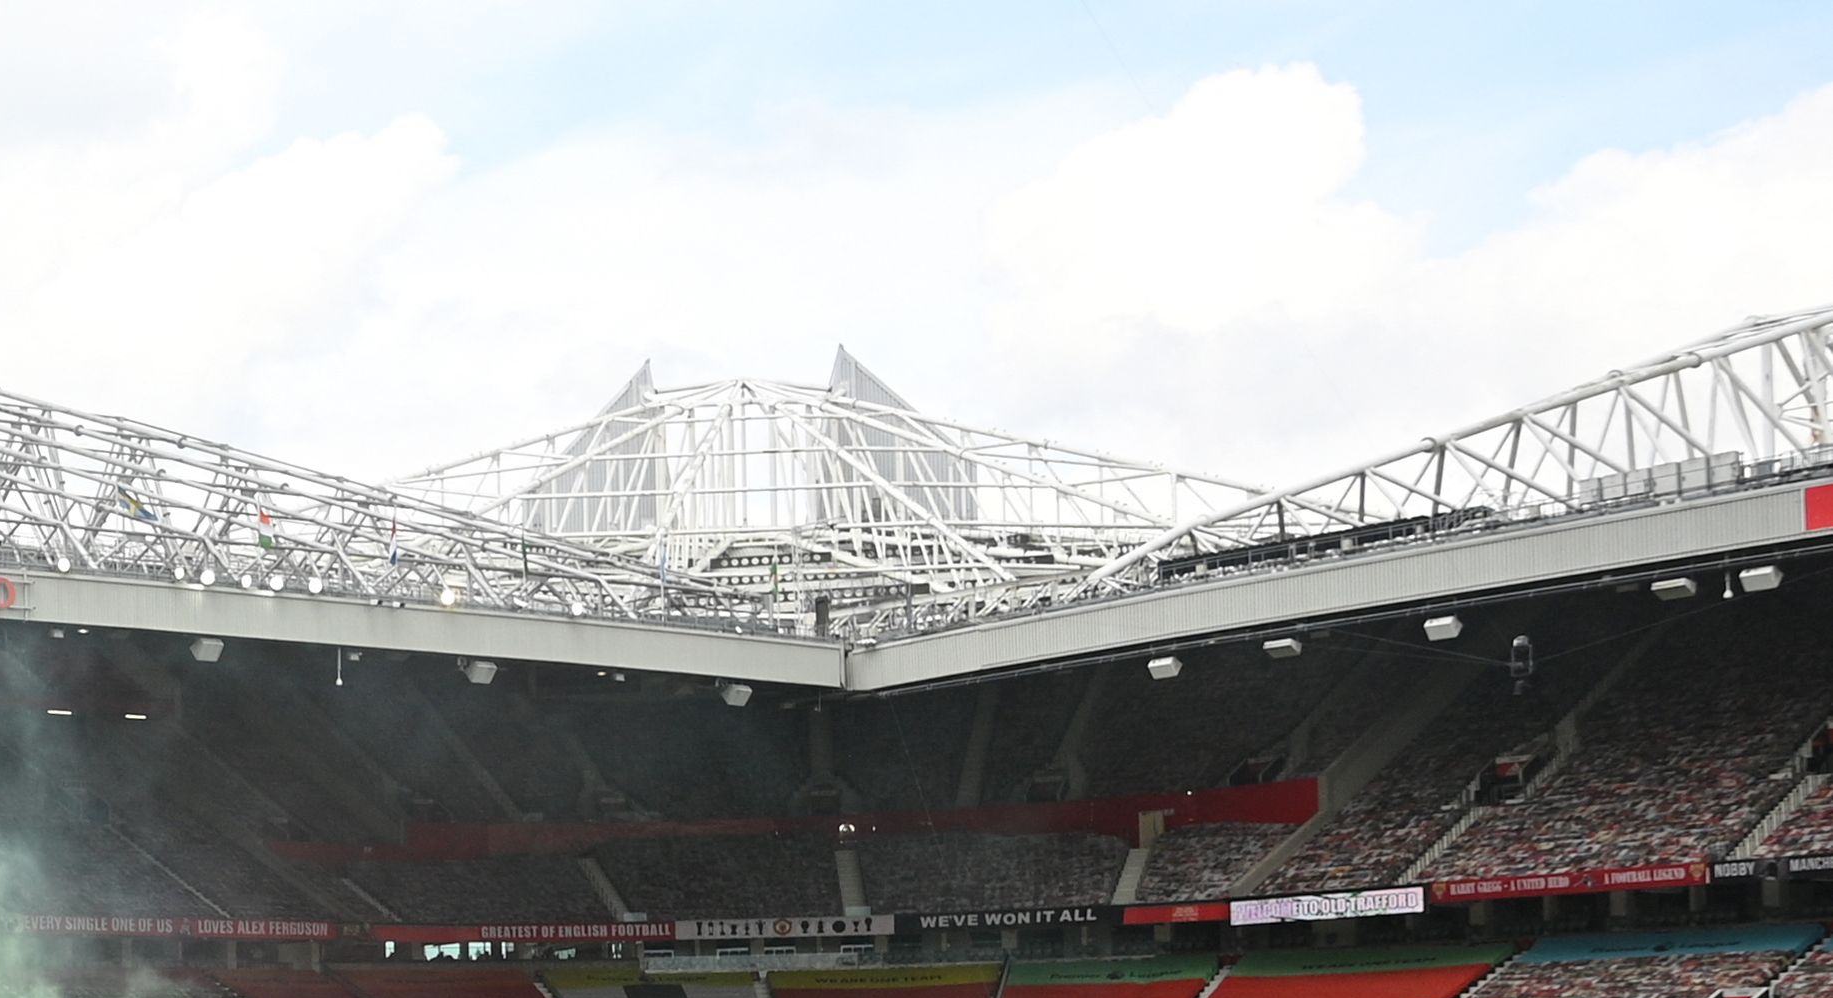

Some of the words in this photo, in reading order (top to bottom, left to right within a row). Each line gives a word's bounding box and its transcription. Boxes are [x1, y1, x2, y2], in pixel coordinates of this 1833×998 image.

[1714, 861, 1756, 878] NOBBY
[1302, 902, 1318, 915] TO
[1322, 899, 1349, 914] OLD
[1351, 893, 1416, 912] TRAFFORD
[26, 915, 62, 931] EVERY
[65, 916, 108, 932] SINGLE
[111, 917, 136, 932] ONE
[138, 918, 154, 932] OF
[157, 919, 173, 933] US
[920, 913, 979, 928] WE'VE
[985, 911, 1031, 926] WON
[1036, 910, 1055, 923] IT
[1059, 908, 1097, 922] ALL
[198, 919, 234, 934] LOVES
[237, 920, 265, 935] ALEX
[269, 921, 328, 936] FERGUSON
[481, 925, 538, 938] GREATEST
[542, 925, 555, 938] OF
[558, 925, 607, 938] ENGLISH
[611, 924, 671, 937] FOOTBALL
